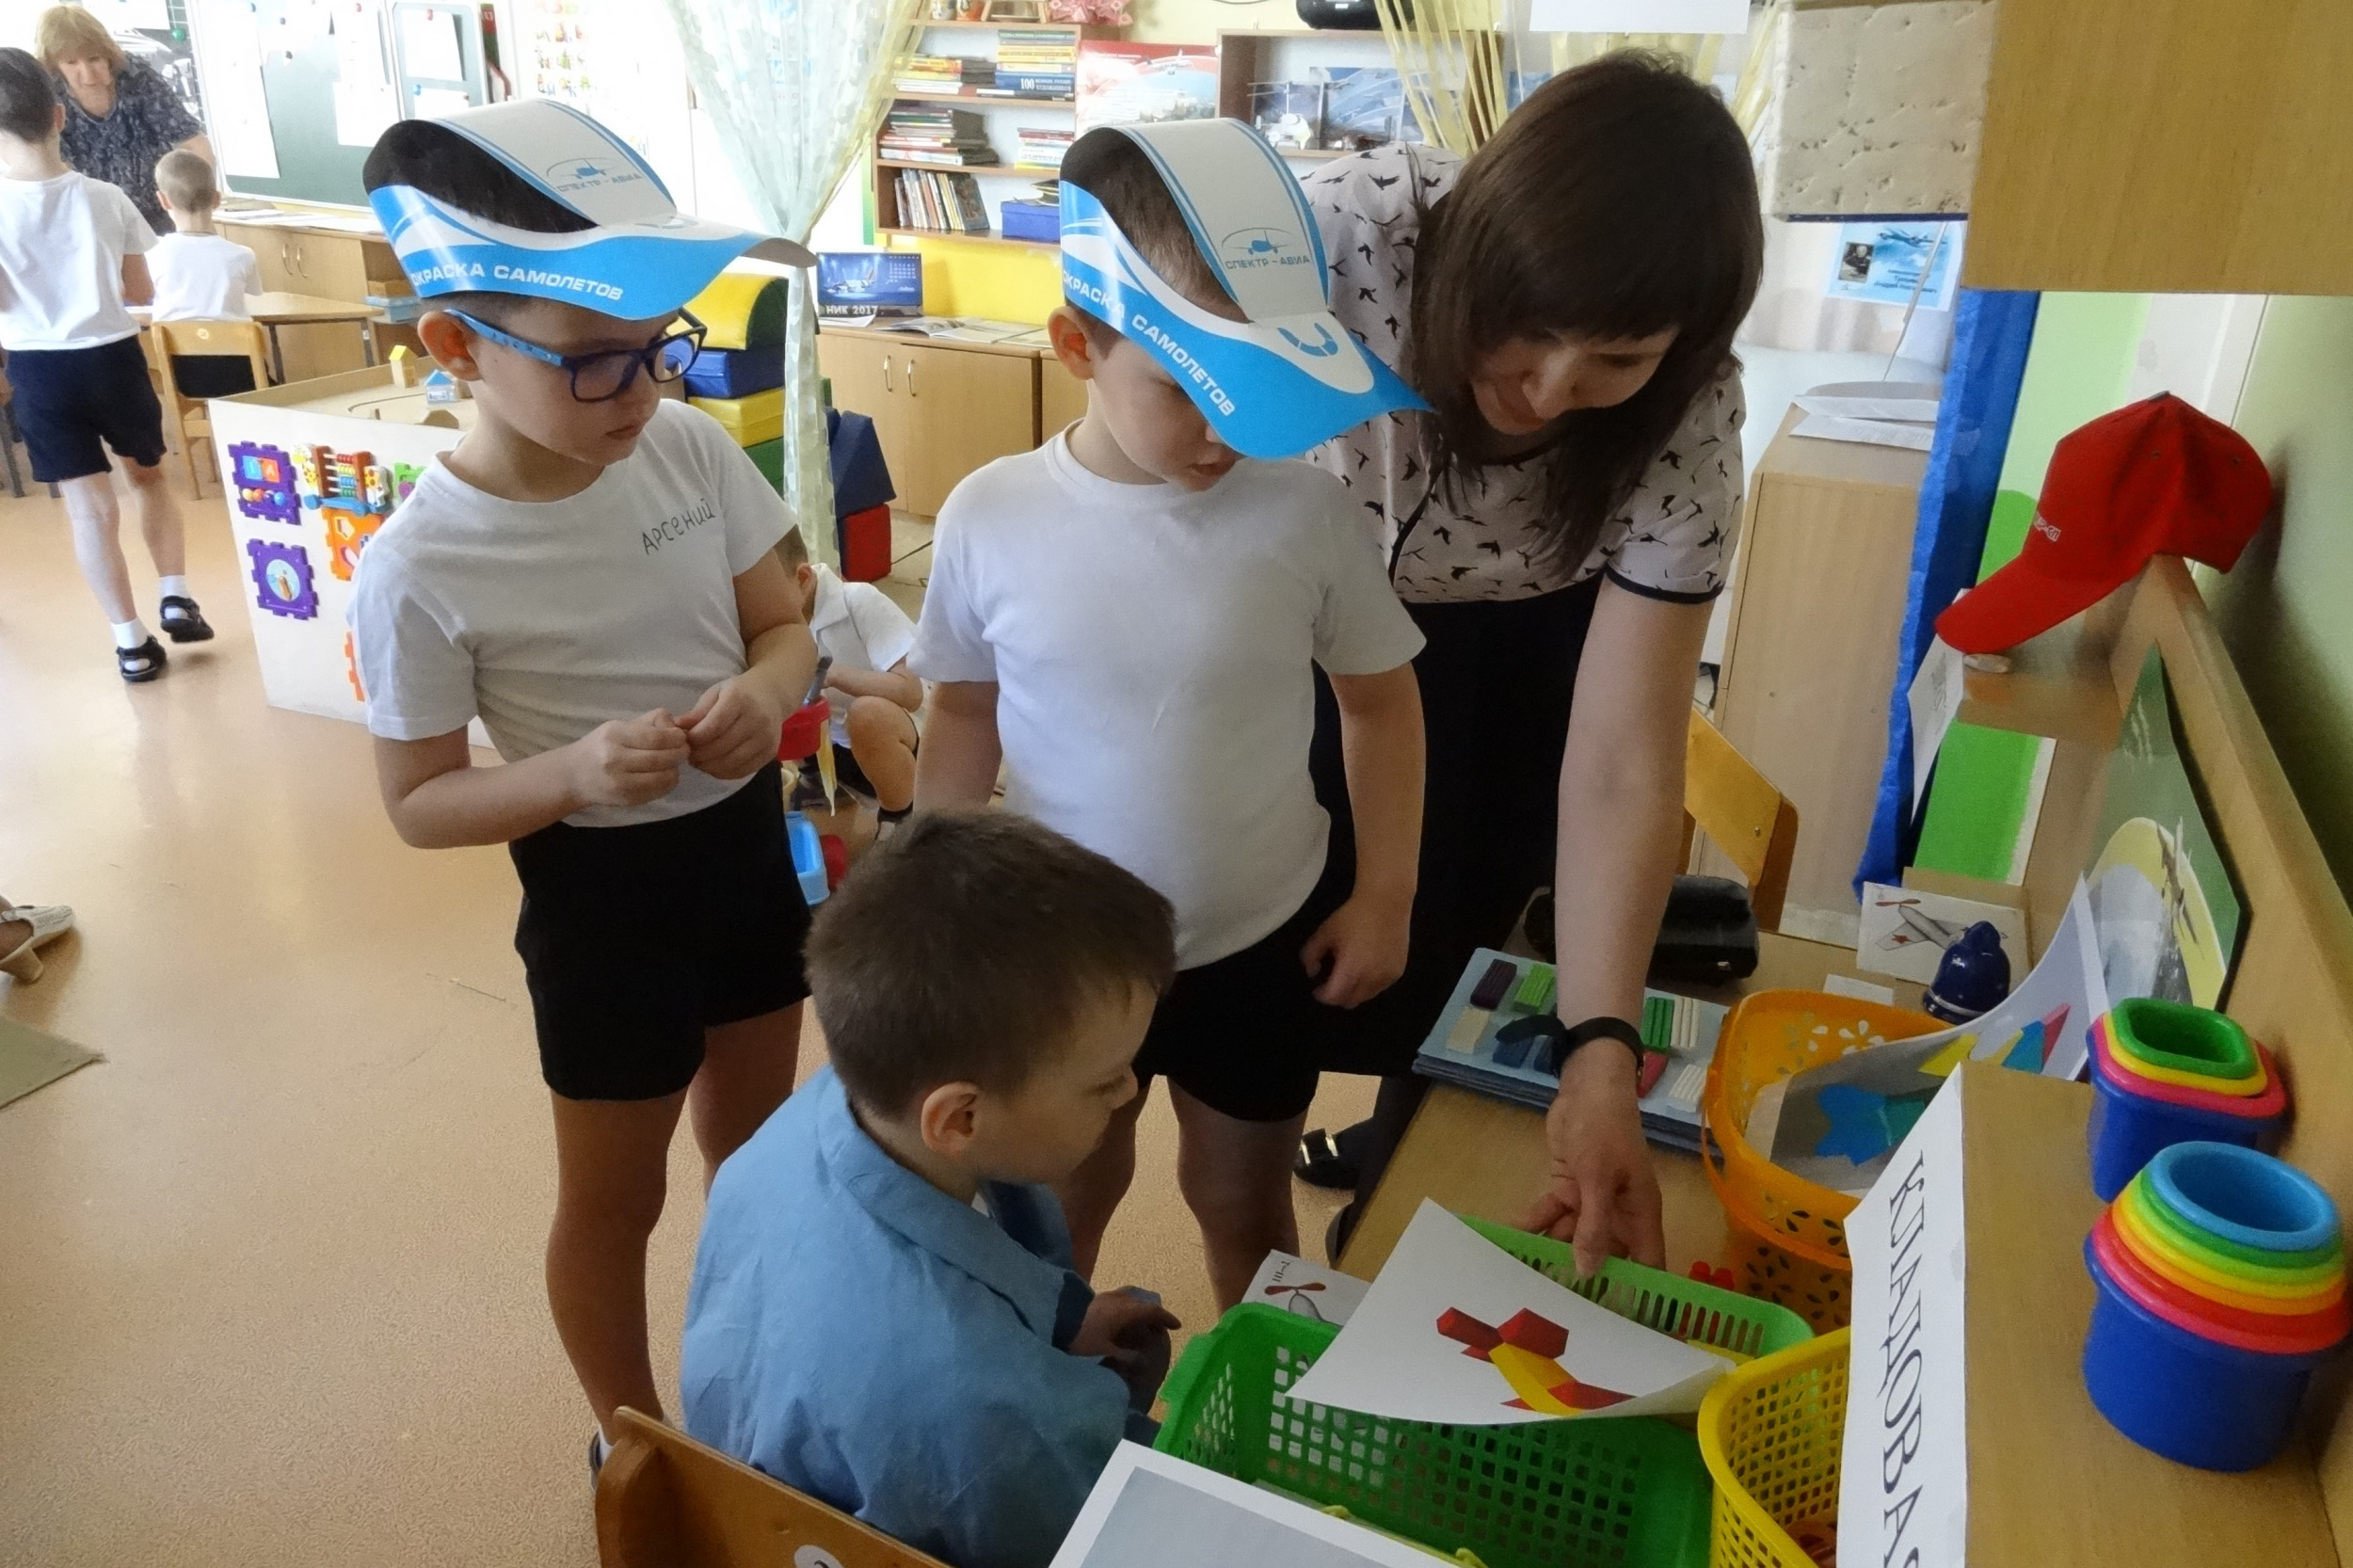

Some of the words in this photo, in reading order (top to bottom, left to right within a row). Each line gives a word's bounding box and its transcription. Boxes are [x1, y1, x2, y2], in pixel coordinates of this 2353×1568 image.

[1019, 77, 1035, 90] 100
[1225, 257, 1270, 270] СПЕКТР
[1280, 254, 1310, 265] АВИА
[493, 264, 624, 301] САМОЛЕТОВ
[853, 304, 879, 315] 2017
[1131, 313, 1236, 417] САМОЛЕТОВ
